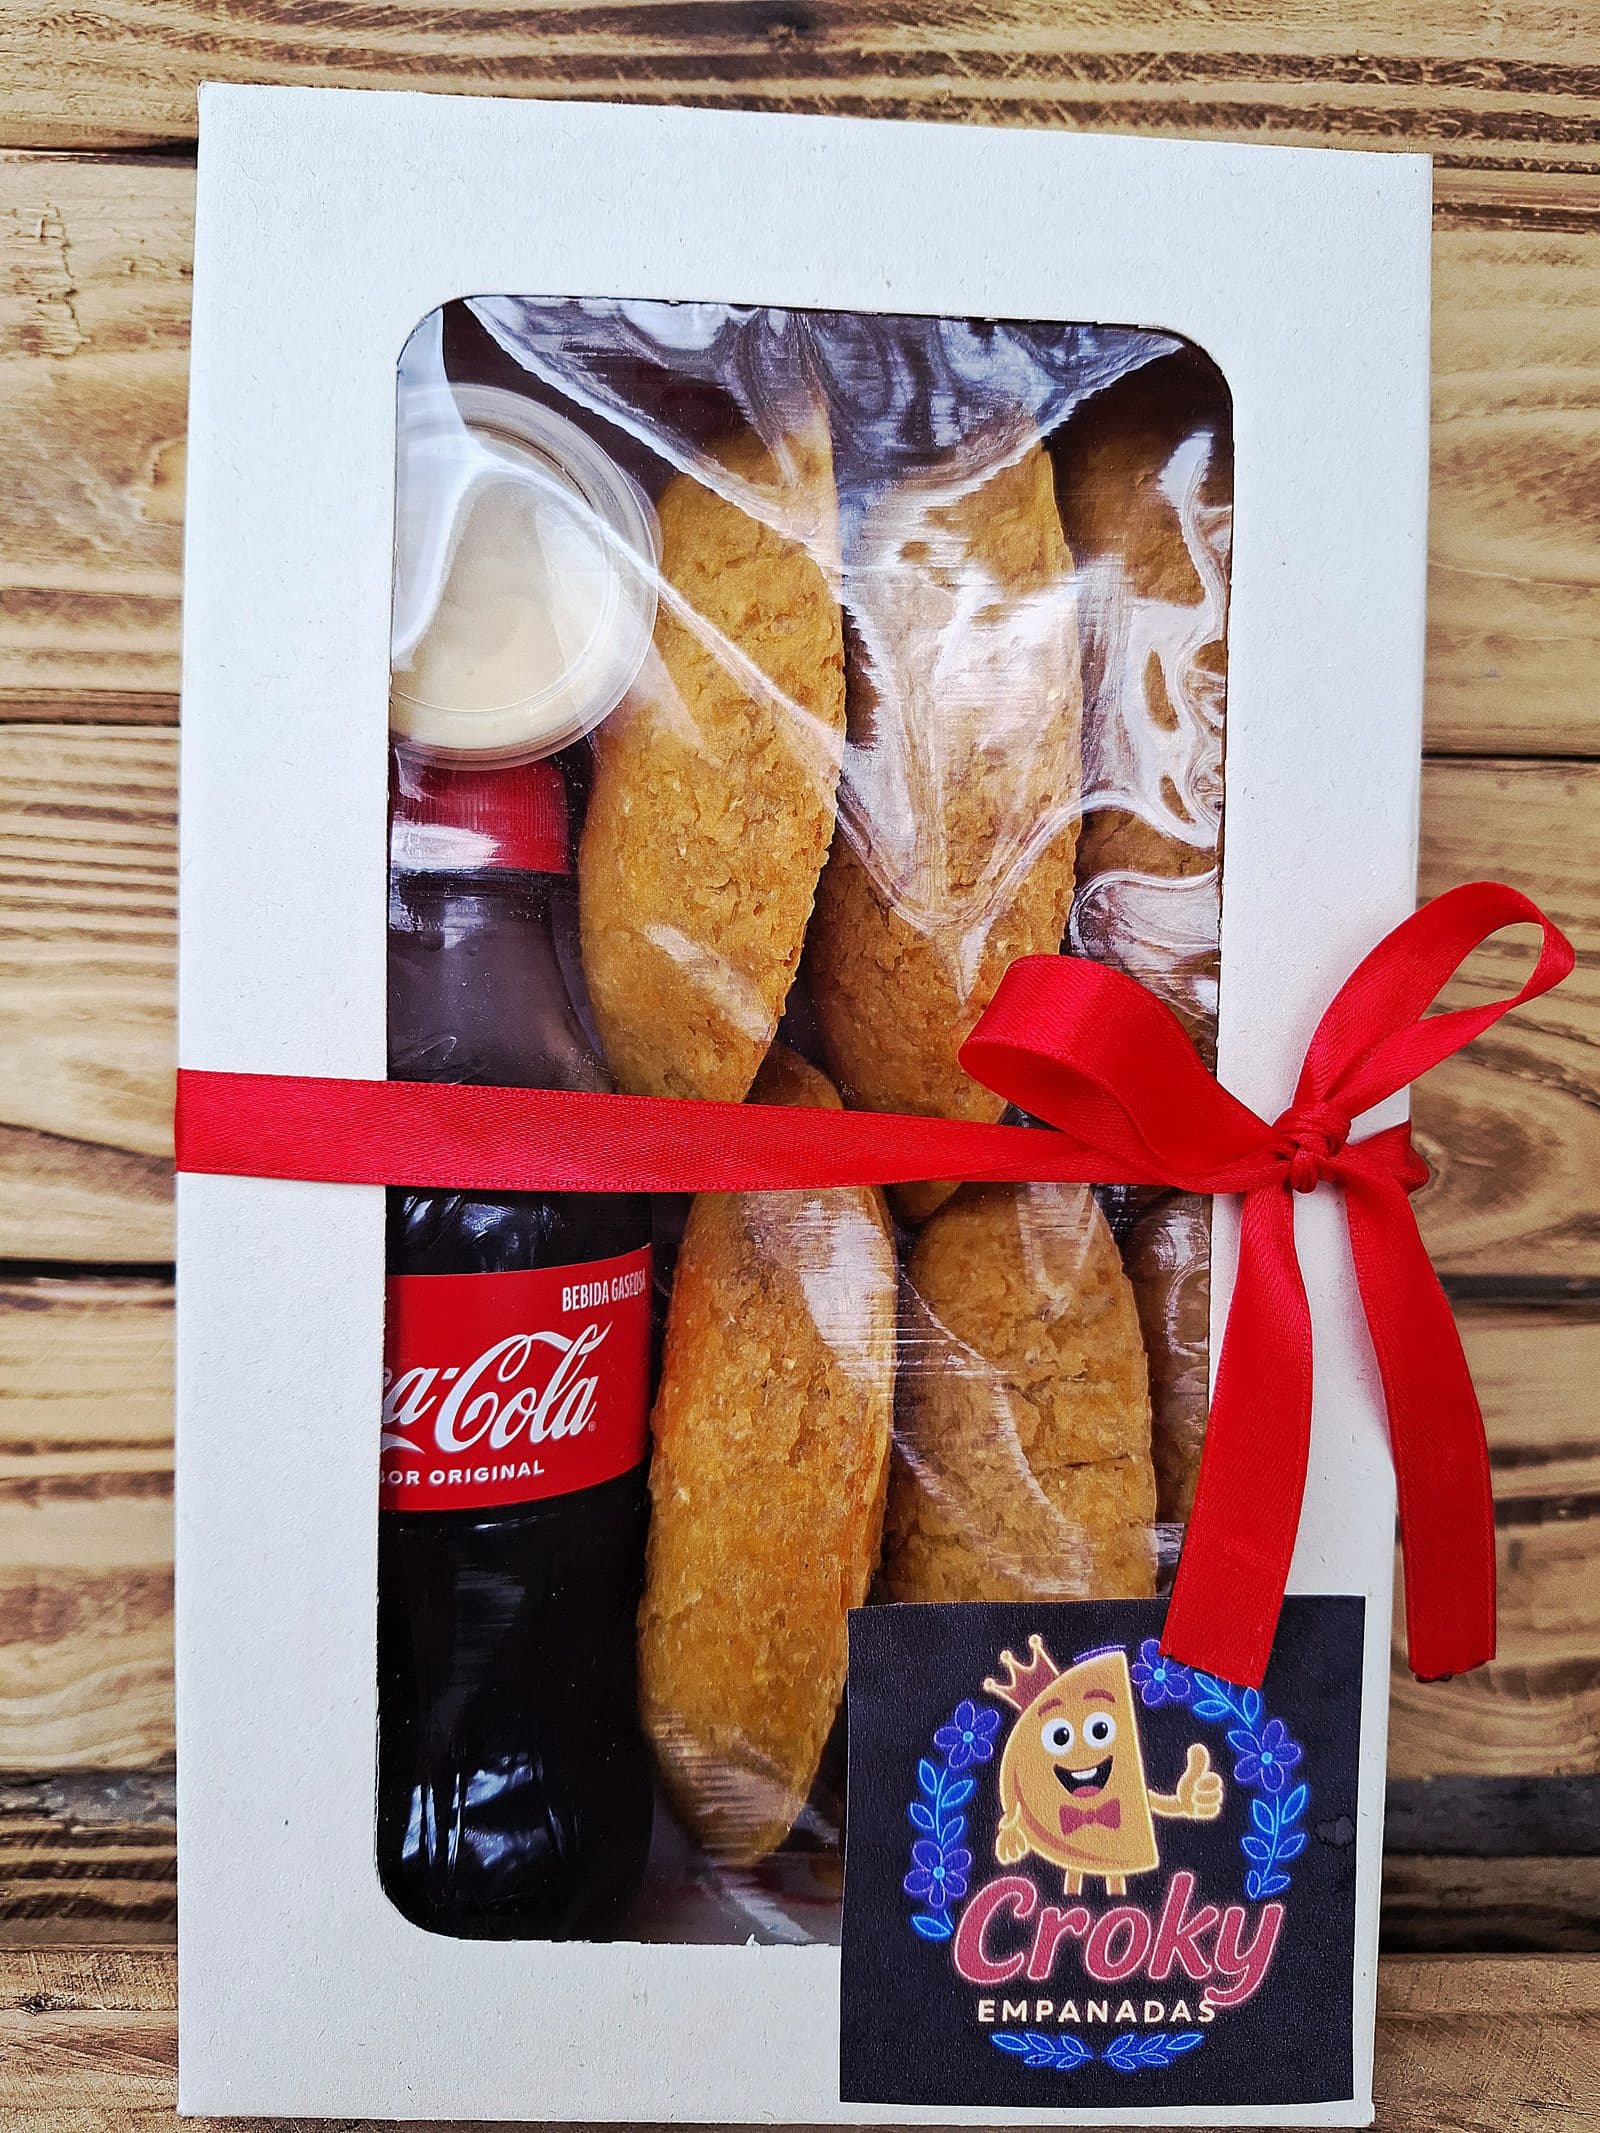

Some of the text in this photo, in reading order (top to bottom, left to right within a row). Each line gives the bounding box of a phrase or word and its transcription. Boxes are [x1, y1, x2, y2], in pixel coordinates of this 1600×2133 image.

[562, 1280, 609, 1312] BEBIDA
[381, 1321, 613, 1452] a-Cola
[429, 1459, 545, 1486] ORIGINAL
[953, 1871, 1284, 2005] Croky
[977, 1999, 1216, 2023] EMPANADAS
